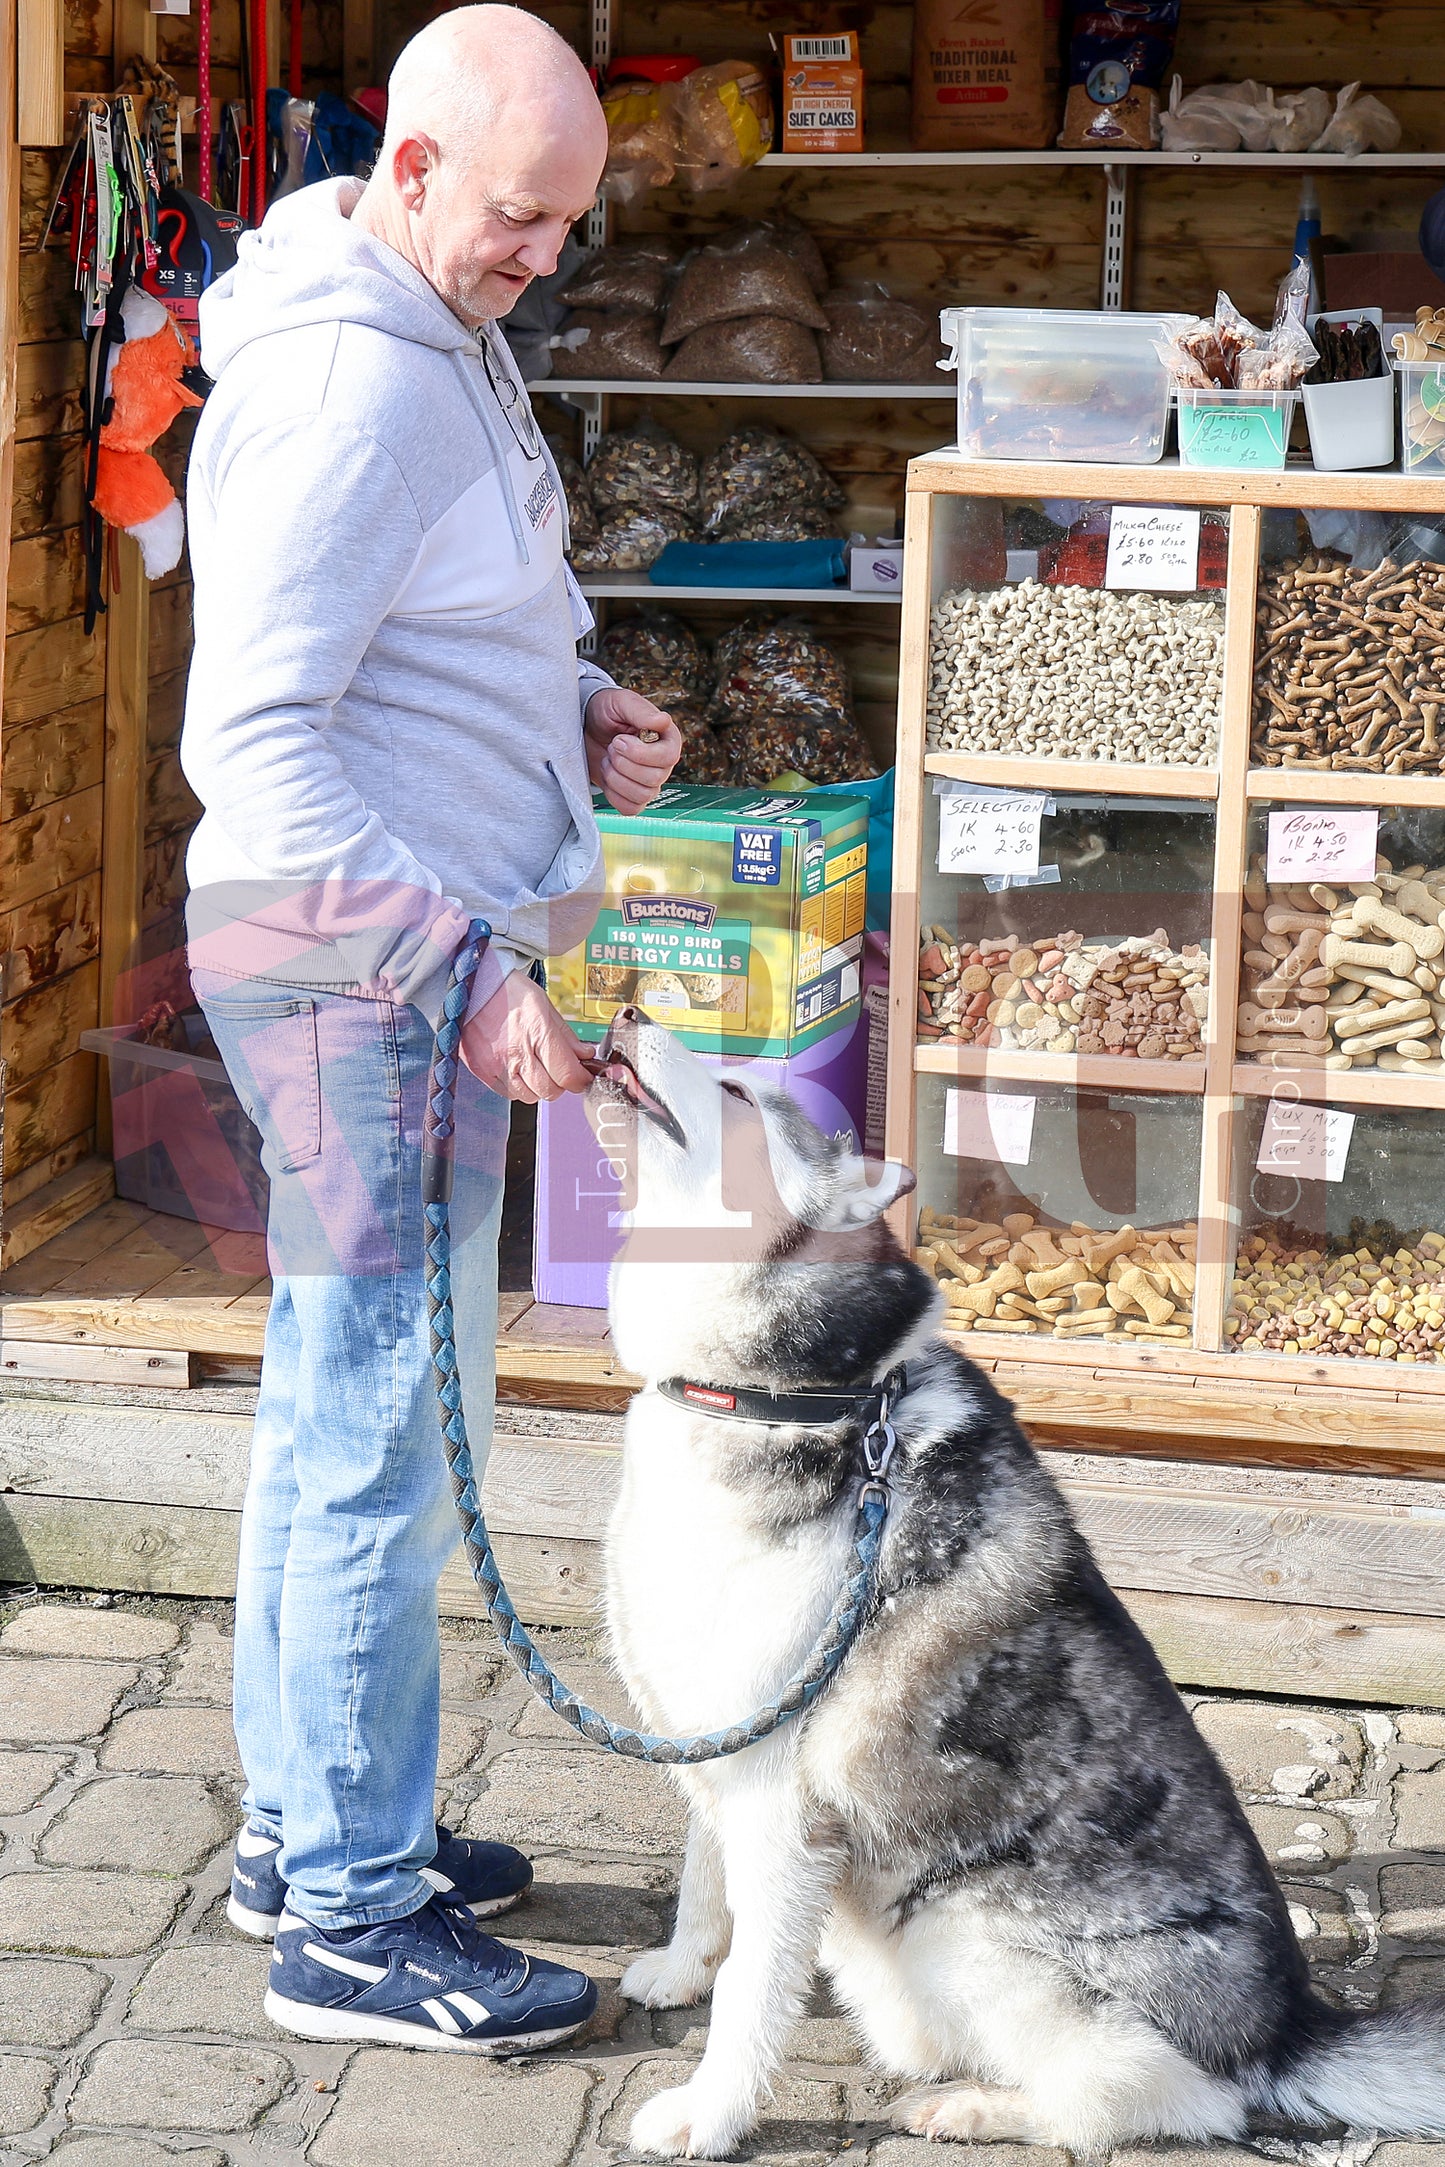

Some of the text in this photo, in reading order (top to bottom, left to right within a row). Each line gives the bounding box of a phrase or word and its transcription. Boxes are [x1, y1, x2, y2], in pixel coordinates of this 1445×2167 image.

[930, 49, 1017, 66] TRADITIONAL
[933, 69, 1012, 84] MIXER MEAL
[955, 90, 988, 101] Adult
[803, 100, 821, 109] HIGH
[823, 99, 849, 109] ENERGY
[789, 112, 854, 127] SUET CAKES
[159, 270, 175, 280] XS
[1161, 537, 1186, 547] KILO
[947, 798, 1043, 816] SELECTION
[740, 833, 773, 849] VAT
[740, 849, 772, 862] FREE
[629, 902, 709, 924] Bucktons
[612, 931, 722, 949] 150 WILD BIRD
[591, 943, 742, 970] ENERGY BALLS
[1312, 1113, 1339, 1127] MIX
[404, 1960, 443, 1983] Reebok
